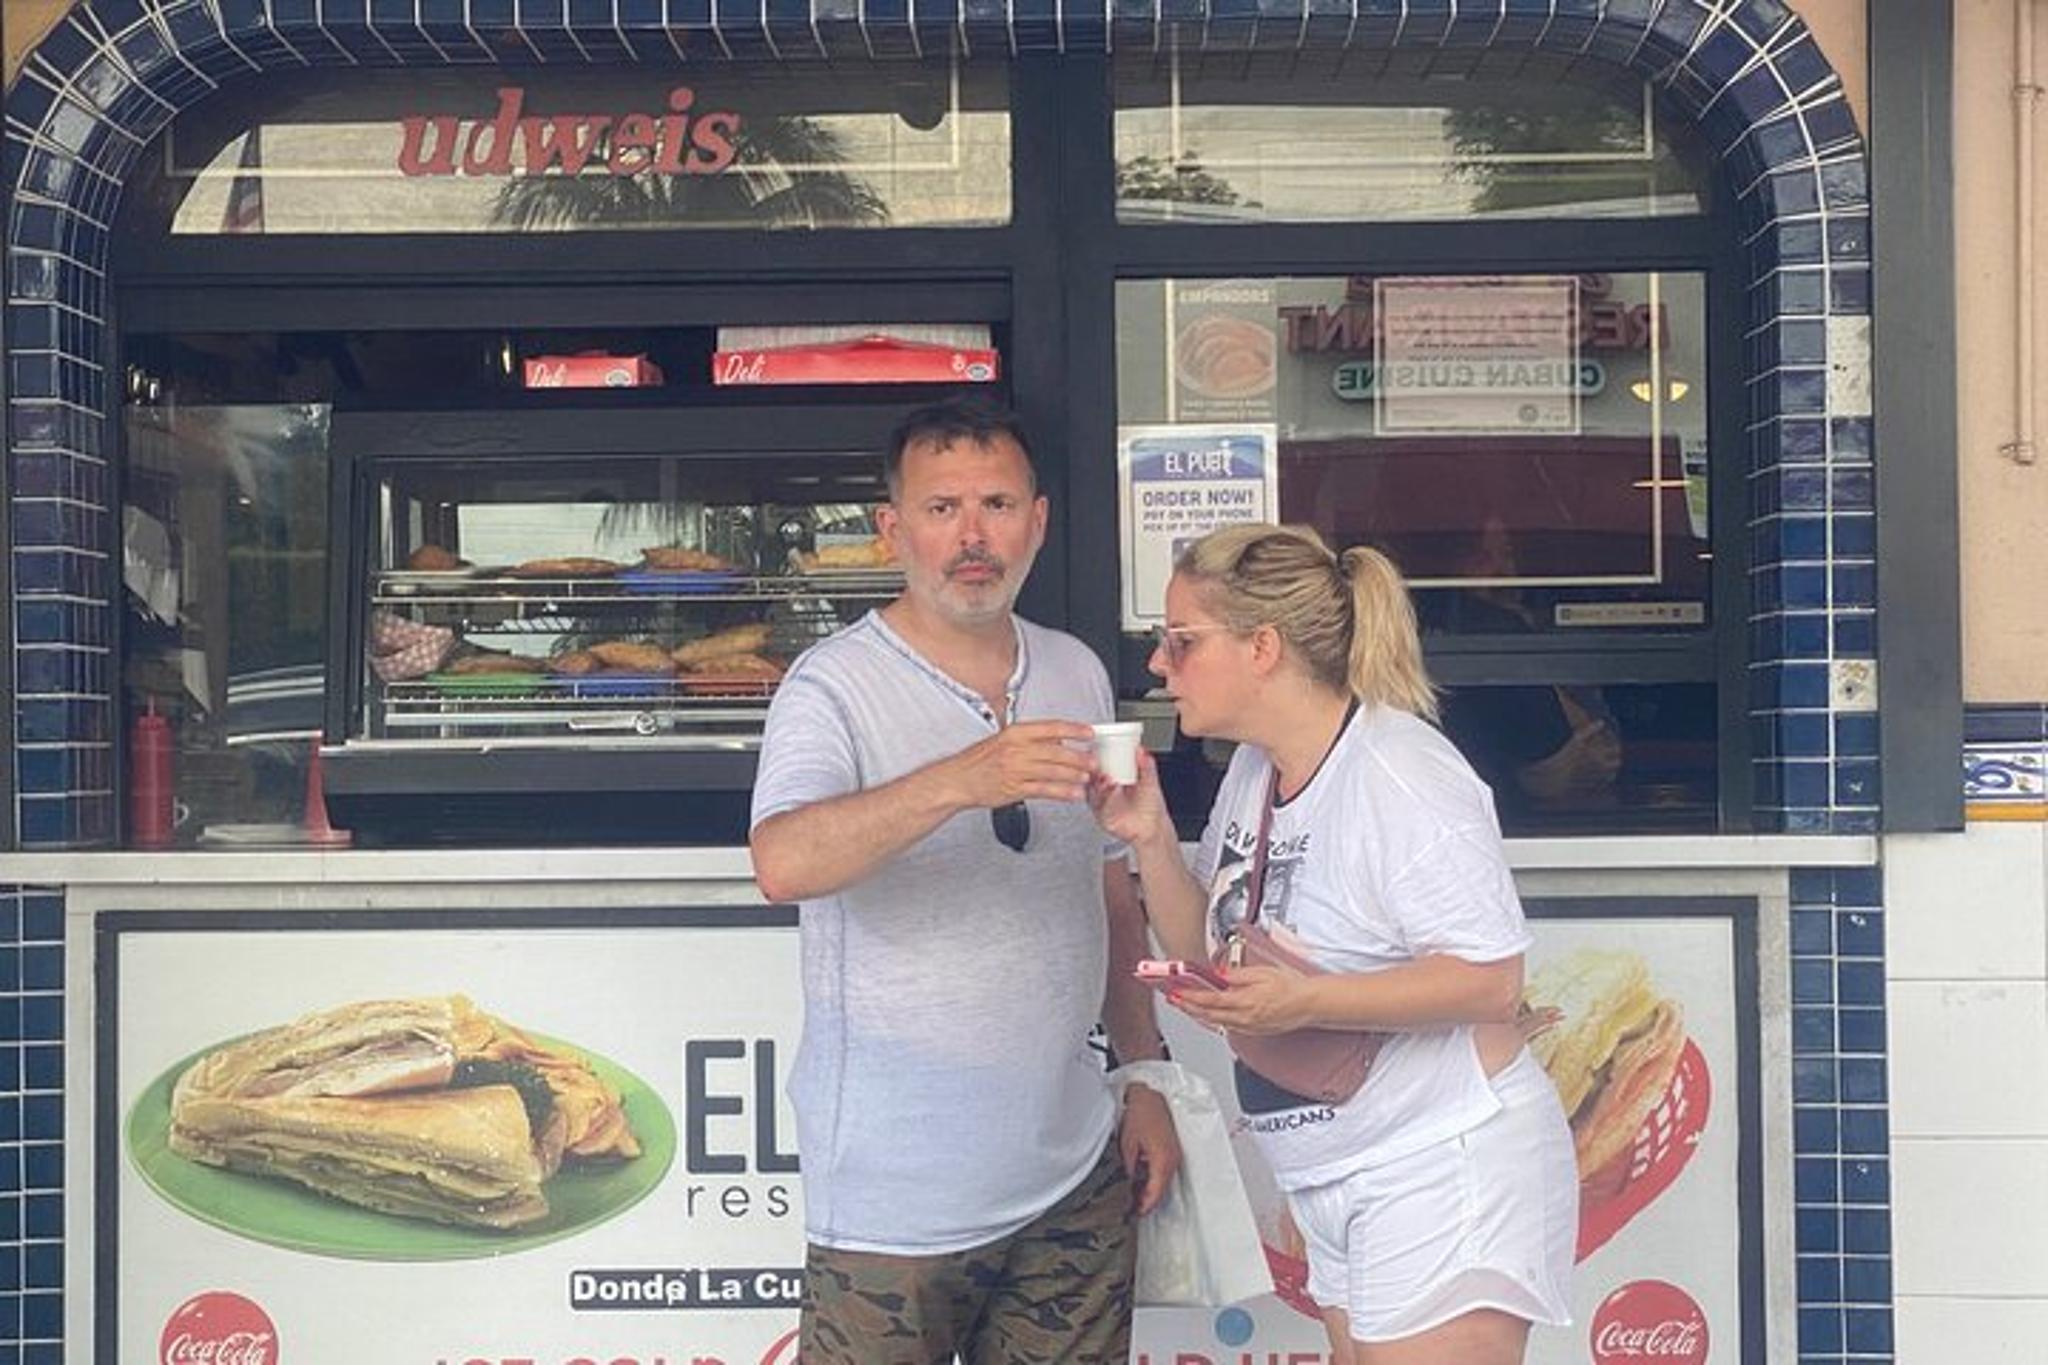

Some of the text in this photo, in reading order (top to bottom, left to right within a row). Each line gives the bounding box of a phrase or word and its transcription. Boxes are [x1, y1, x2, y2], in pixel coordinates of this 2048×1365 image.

[399, 88, 740, 177] udweis
[724, 354, 766, 382] Deli
[1165, 451, 1185, 473] EL
[1143, 489, 1254, 507] ORDER NOW!
[1168, 510, 1184, 520] ON
[1188, 510, 1215, 520] YOUR
[1217, 508, 1253, 519] PHONE
[686, 1039, 802, 1174] EL
[699, 1272, 743, 1300] La
